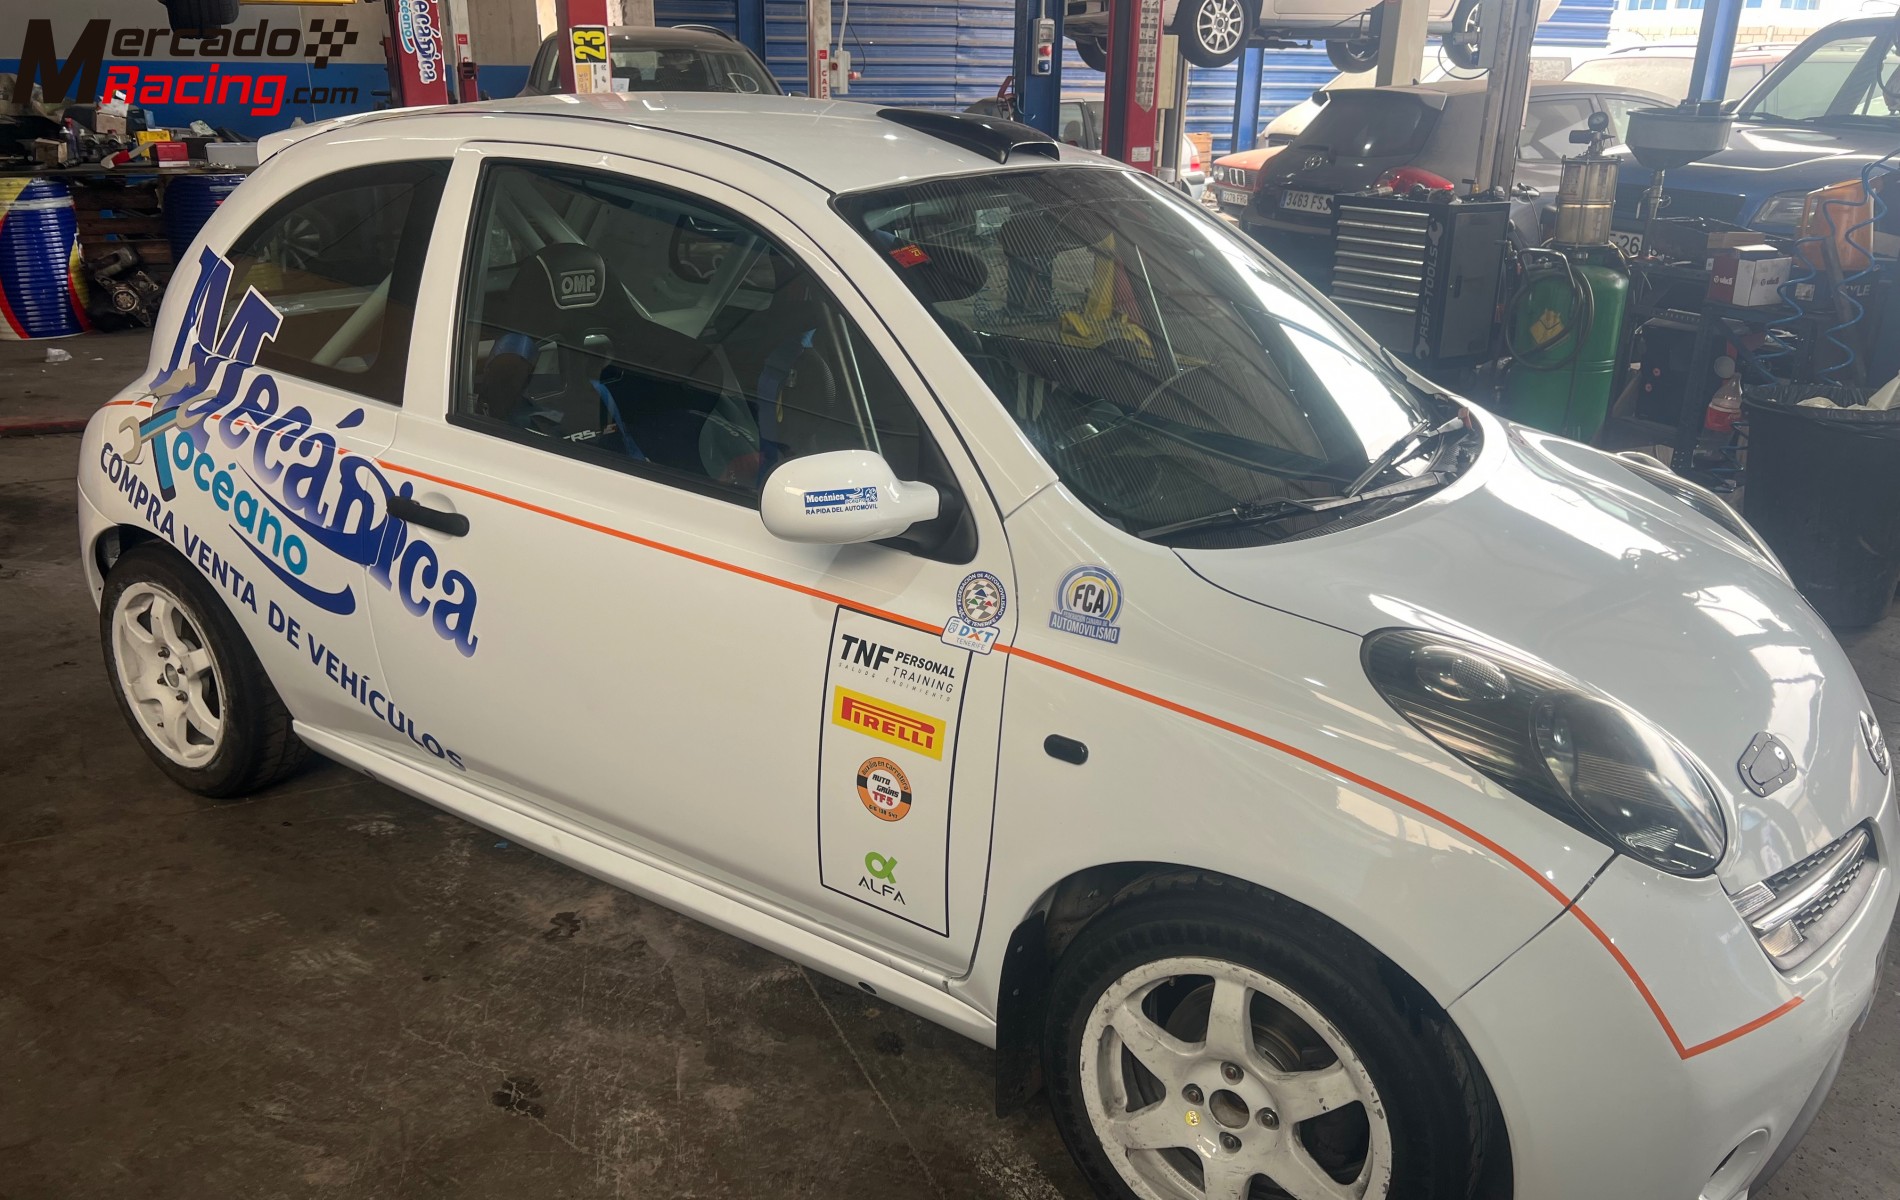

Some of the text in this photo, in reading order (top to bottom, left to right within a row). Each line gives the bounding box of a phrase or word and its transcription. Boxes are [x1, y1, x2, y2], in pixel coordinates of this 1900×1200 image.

[401, 0, 412, 37] céano
[413, 0, 439, 82] ecánica
[573, 30, 606, 60] 23
[1286, 192, 1309, 208] 3463
[1610, 232, 1640, 254] 26
[561, 274, 596, 294] OMP
[149, 245, 479, 658] Mecánica
[172, 432, 308, 576] océano
[806, 492, 845, 503] Mecánica
[101, 442, 466, 772] COMPRA VENTA DE VEHÍCULOS
[1073, 584, 1105, 613] FCA
[958, 625, 994, 643] DXT
[1051, 613, 1118, 642] AUTOMOVILISMO
[841, 633, 955, 678] TNF PERSONAL
[893, 666, 954, 693] TRAINING
[841, 696, 936, 750] PIRELLI
[872, 791, 894, 806] TF5
[858, 876, 906, 905] ALFA
